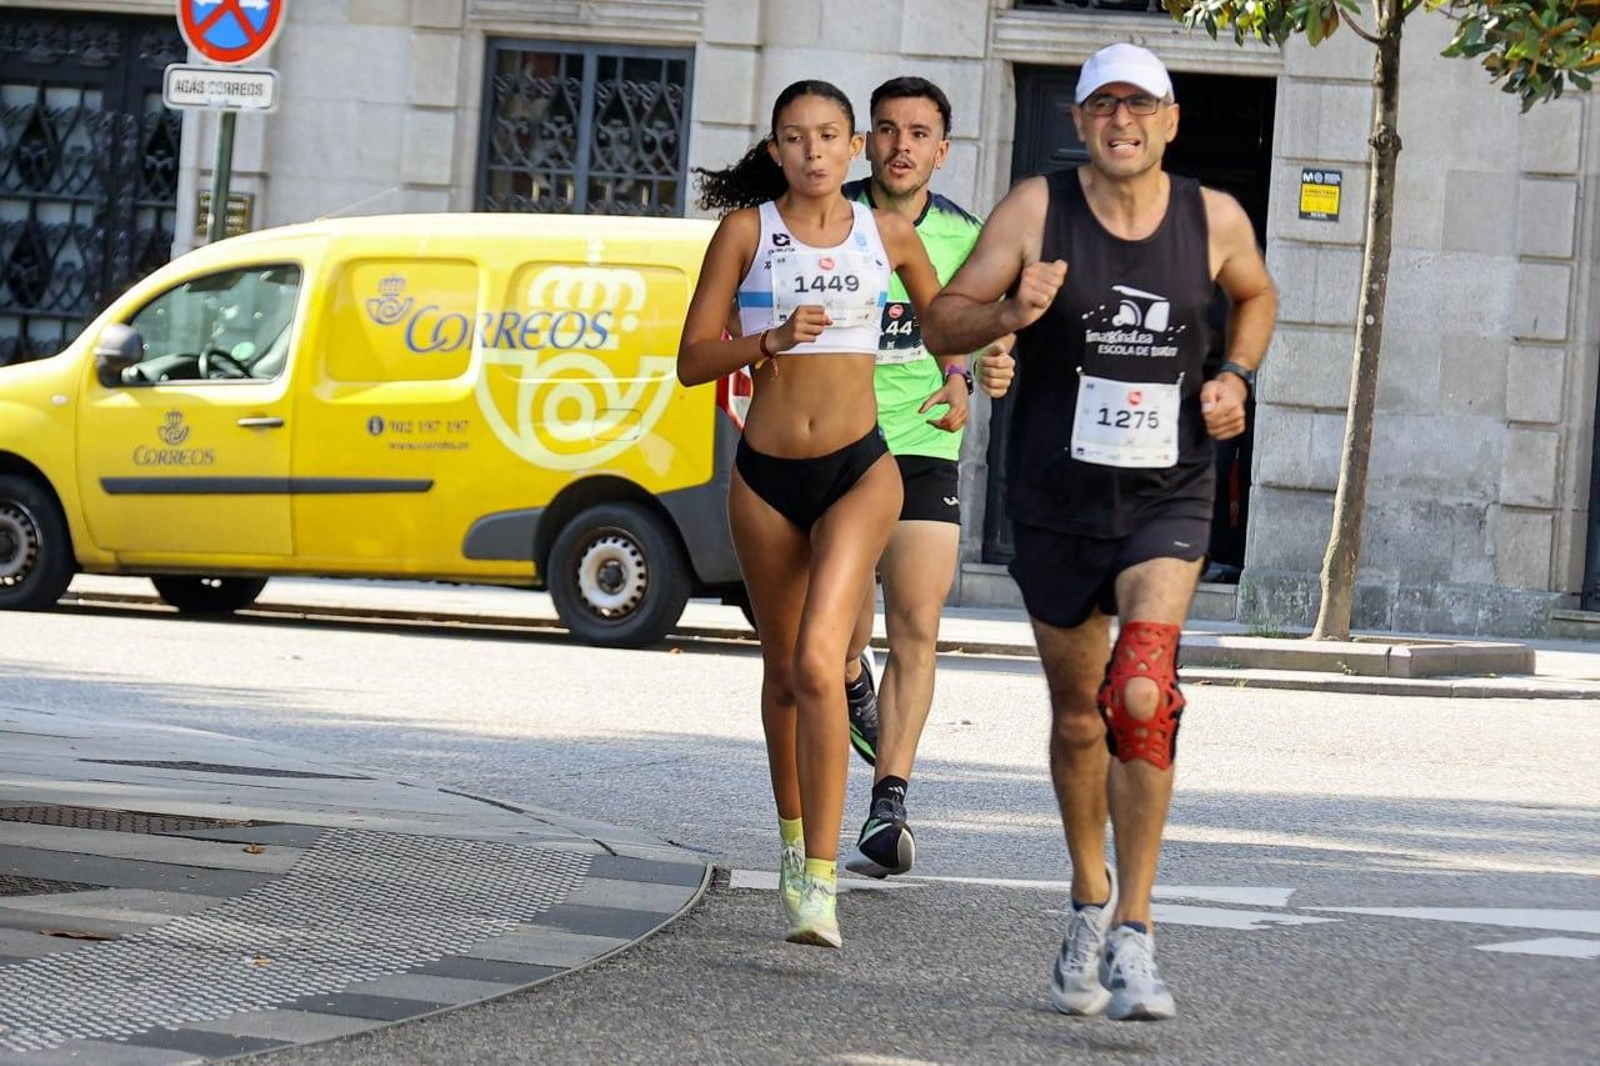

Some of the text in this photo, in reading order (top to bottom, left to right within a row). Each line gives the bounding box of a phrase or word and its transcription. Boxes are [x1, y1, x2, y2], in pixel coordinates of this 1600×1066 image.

[794, 274, 860, 293] 1449
[404, 305, 614, 353] CORREOS
[880, 320, 913, 336] 44
[1098, 344, 1135, 355] ESCOLA
[1097, 407, 1160, 429] 1275
[133, 444, 215, 466] CORREOS
